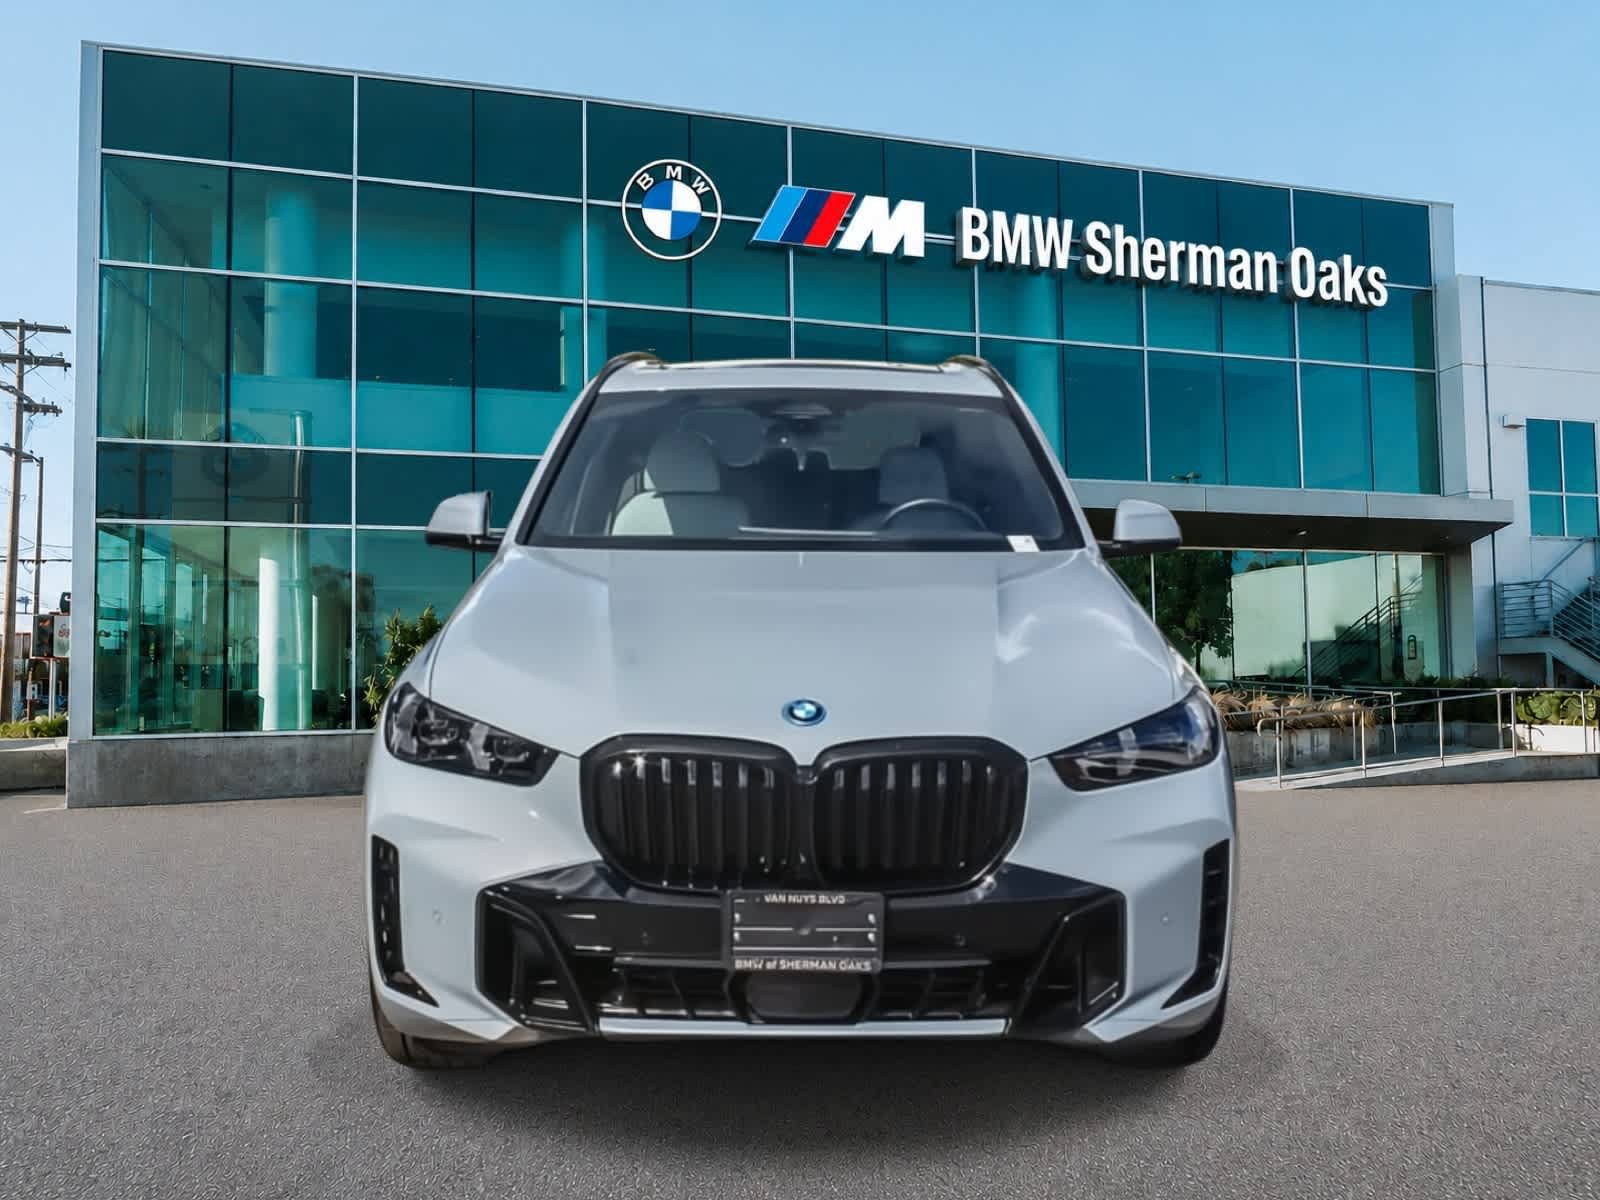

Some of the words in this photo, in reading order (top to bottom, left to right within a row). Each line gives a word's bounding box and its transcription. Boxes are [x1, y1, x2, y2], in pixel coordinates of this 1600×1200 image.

[636, 164, 711, 195] BMW
[837, 194, 926, 258] M
[959, 206, 1074, 270] BMW
[1083, 220, 1278, 293] Sherman
[1288, 247, 1389, 308] Oaks
[764, 894, 787, 904] VAN
[788, 894, 816, 905] NUYS
[818, 895, 846, 905] BLVD
[734, 959, 764, 970] BMW
[765, 960, 777, 970] of
[779, 960, 837, 971] SHERMAN
[838, 960, 873, 972] OAKS
